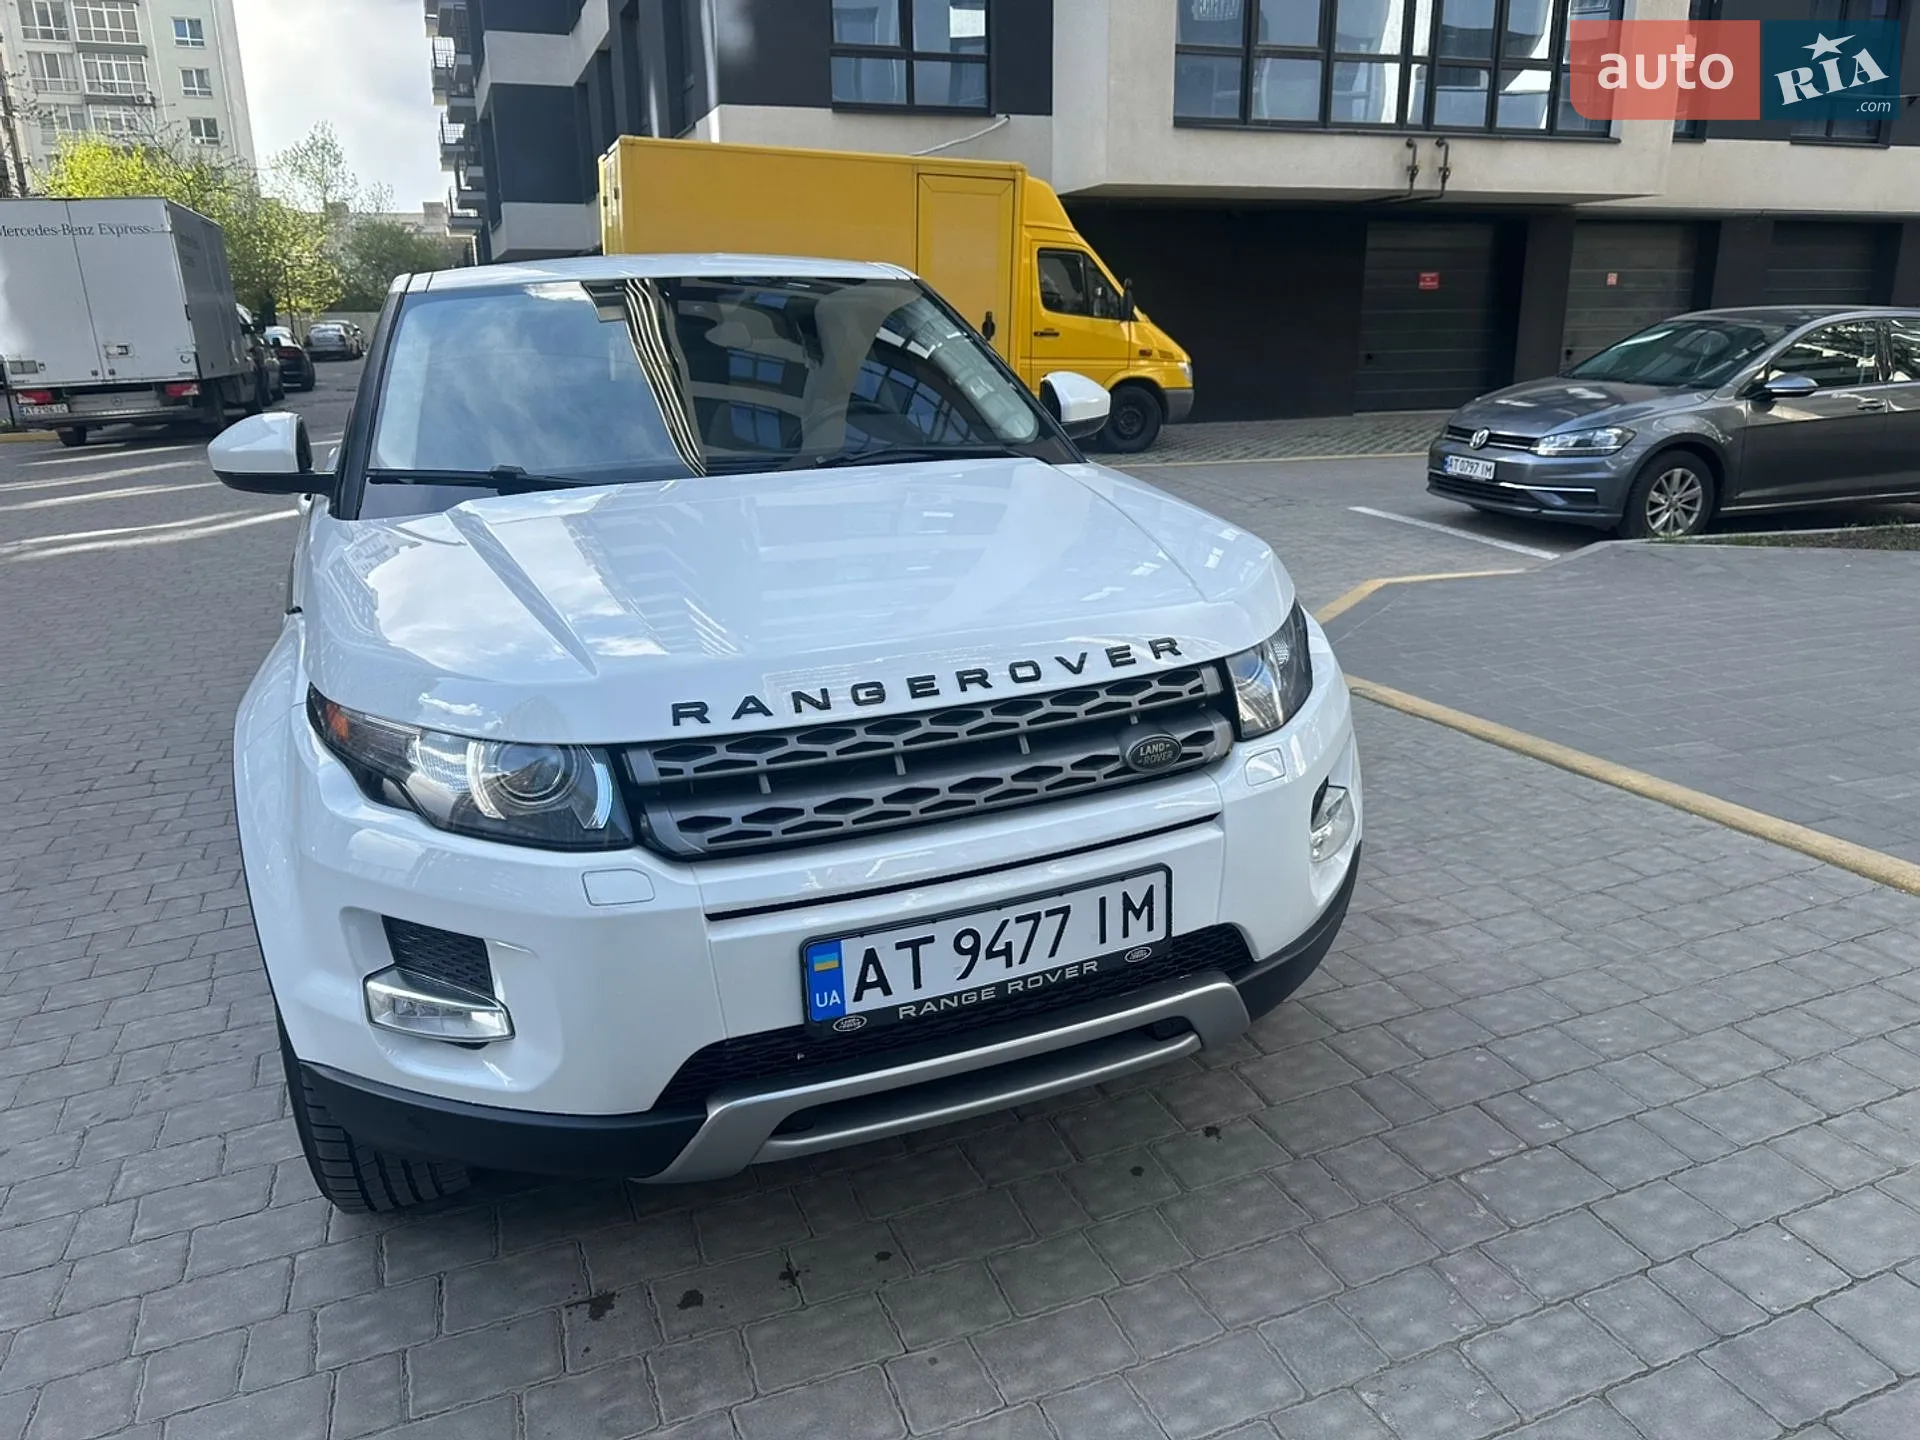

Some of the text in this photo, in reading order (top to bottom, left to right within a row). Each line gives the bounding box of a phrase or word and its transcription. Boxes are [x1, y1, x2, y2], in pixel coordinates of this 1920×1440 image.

[853, 884, 1155, 1003] AT 9477 IM
[815, 989, 841, 1008] UA
[899, 960, 1098, 1020] RANGE ROVER
